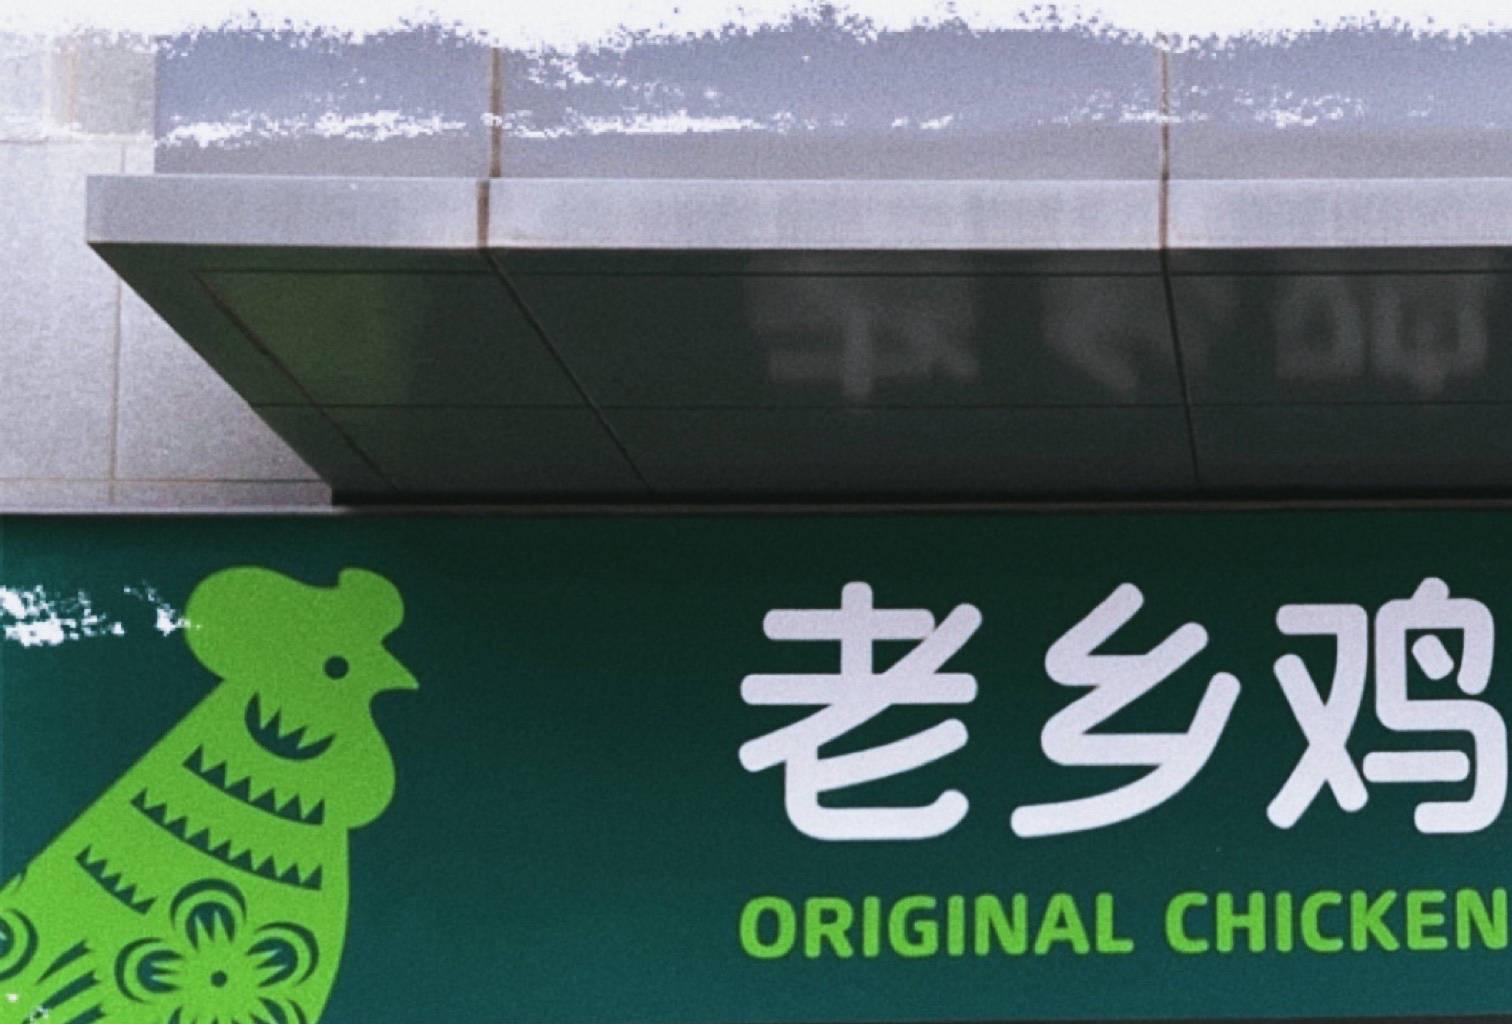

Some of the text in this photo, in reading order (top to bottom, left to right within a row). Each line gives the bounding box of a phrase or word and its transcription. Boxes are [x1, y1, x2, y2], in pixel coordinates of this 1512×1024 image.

[738, 576, 1508, 842] 老乡鸡
[739, 887, 1508, 958] ORIGINAL CHICKEN
